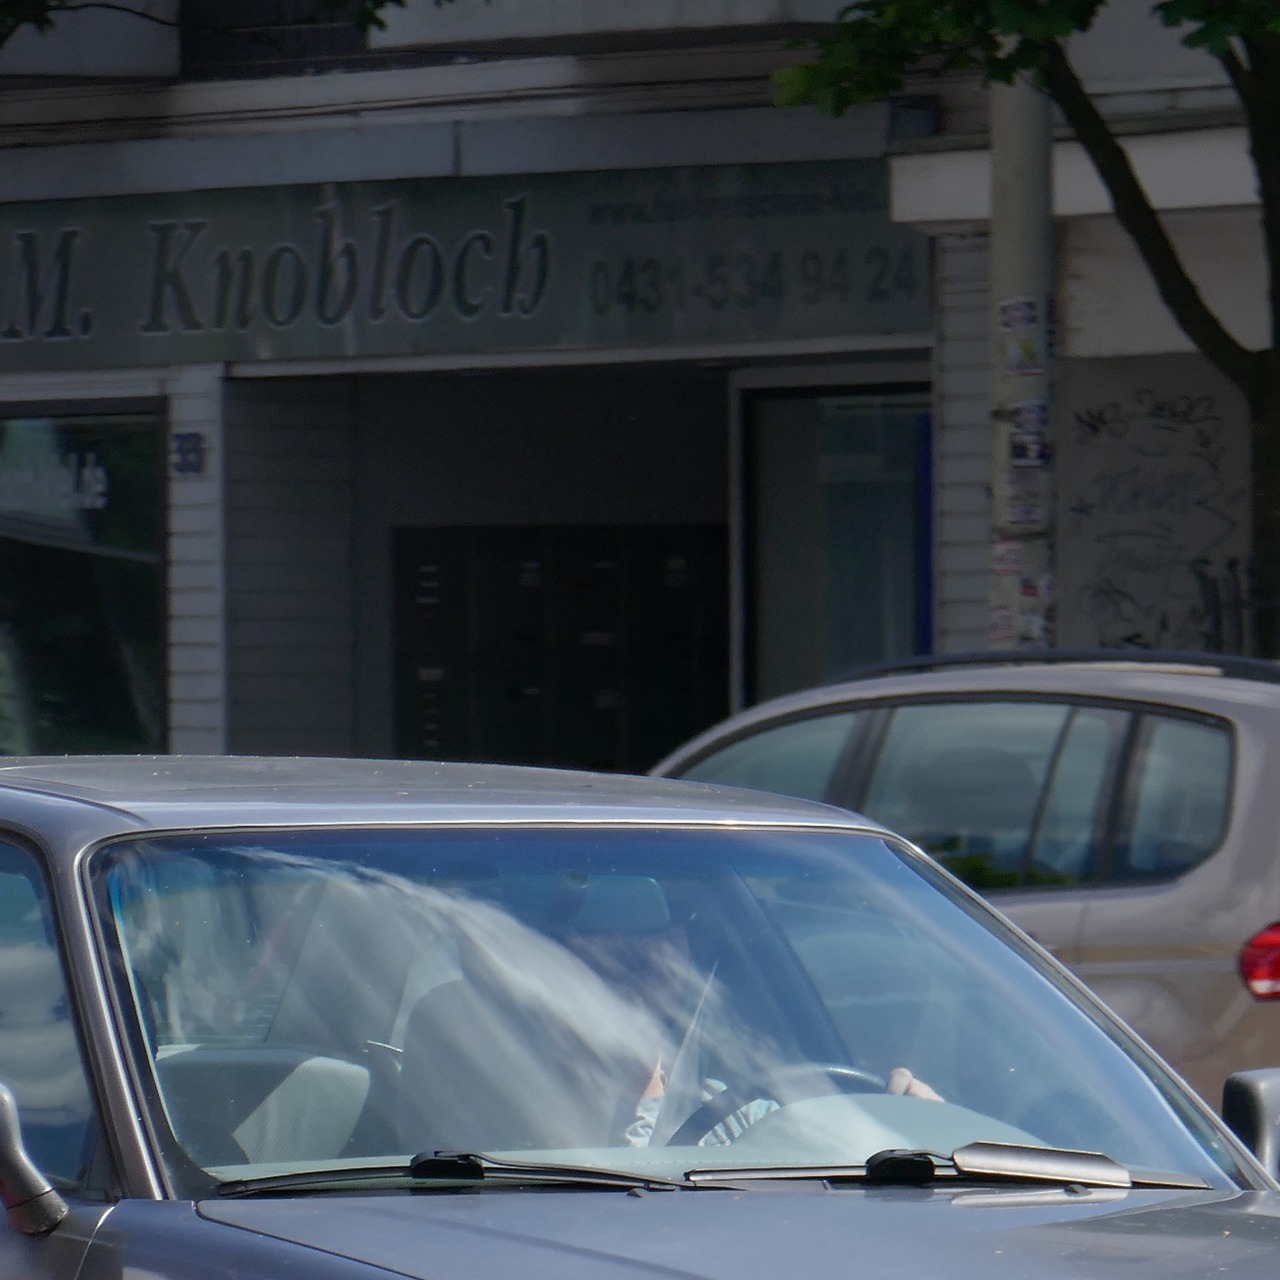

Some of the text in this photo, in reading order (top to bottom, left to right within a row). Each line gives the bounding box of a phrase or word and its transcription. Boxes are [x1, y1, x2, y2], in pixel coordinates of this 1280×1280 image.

[1, 226, 95, 338] M.
[140, 197, 549, 333] Knobloch
[798, 245, 850, 306] 94
[864, 244, 918, 303] 24
